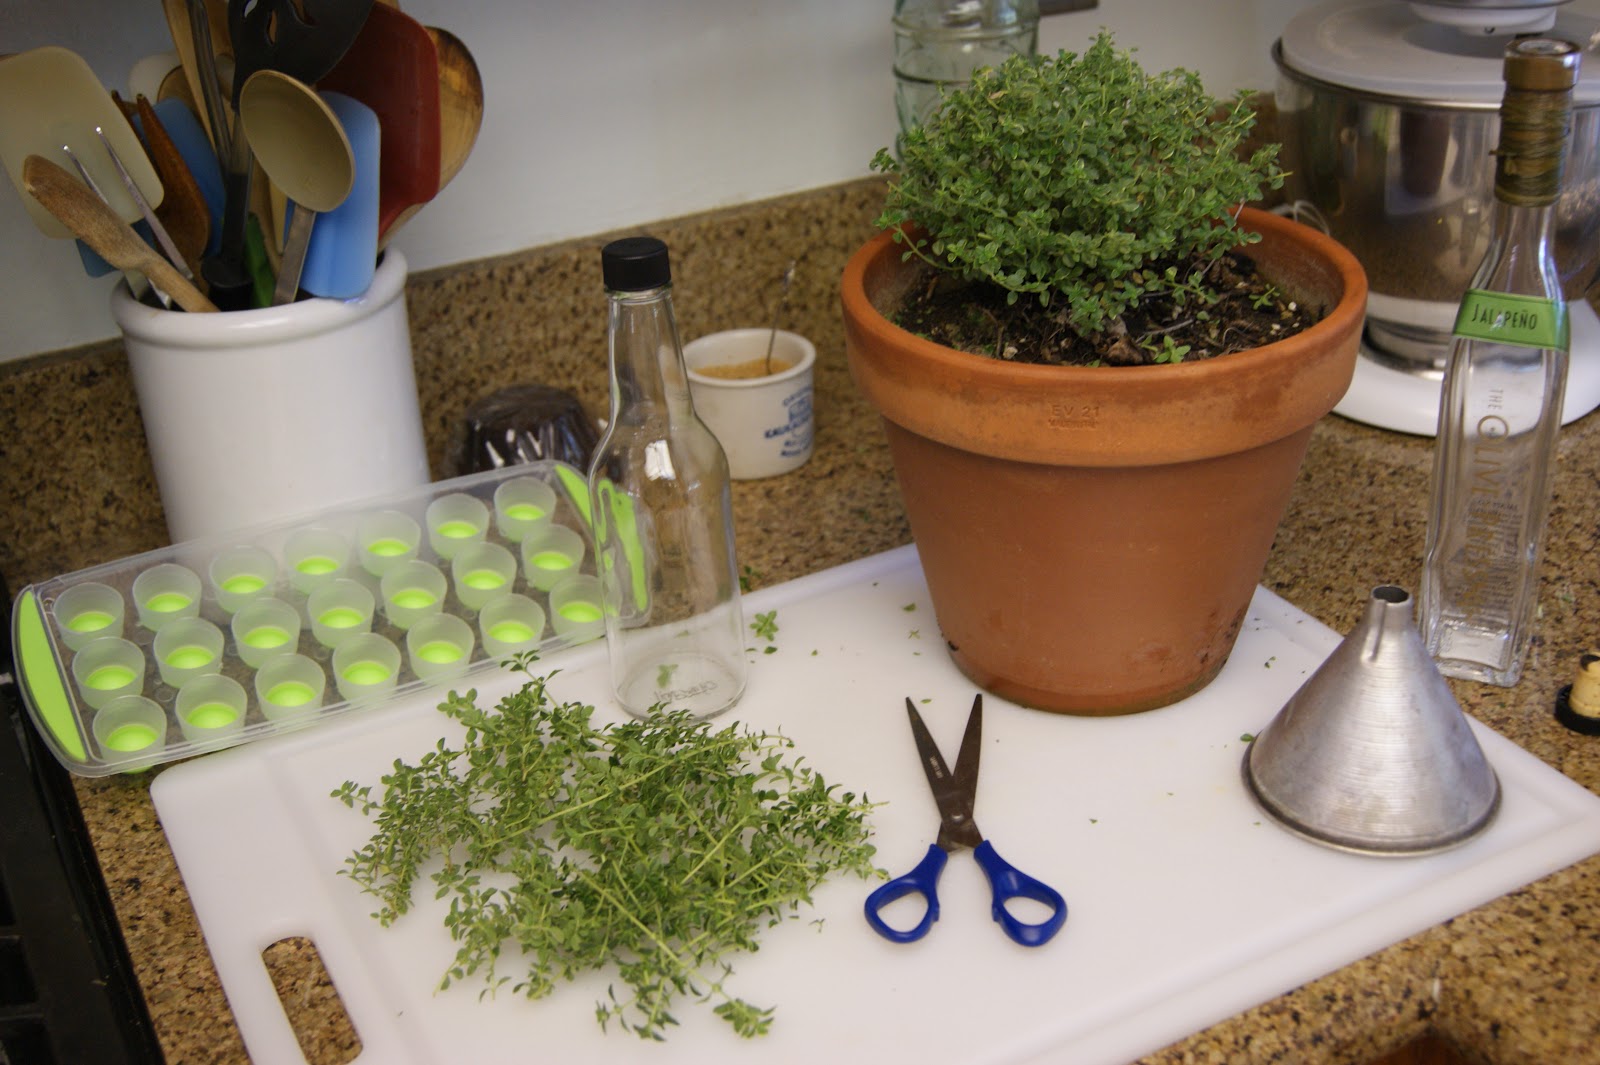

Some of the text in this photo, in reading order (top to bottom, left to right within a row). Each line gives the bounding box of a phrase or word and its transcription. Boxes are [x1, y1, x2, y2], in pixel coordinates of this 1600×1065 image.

[1488, 389, 1504, 410] THE
[1051, 404, 1100, 418] EV 21
[1471, 414, 1510, 499] OLIVE
